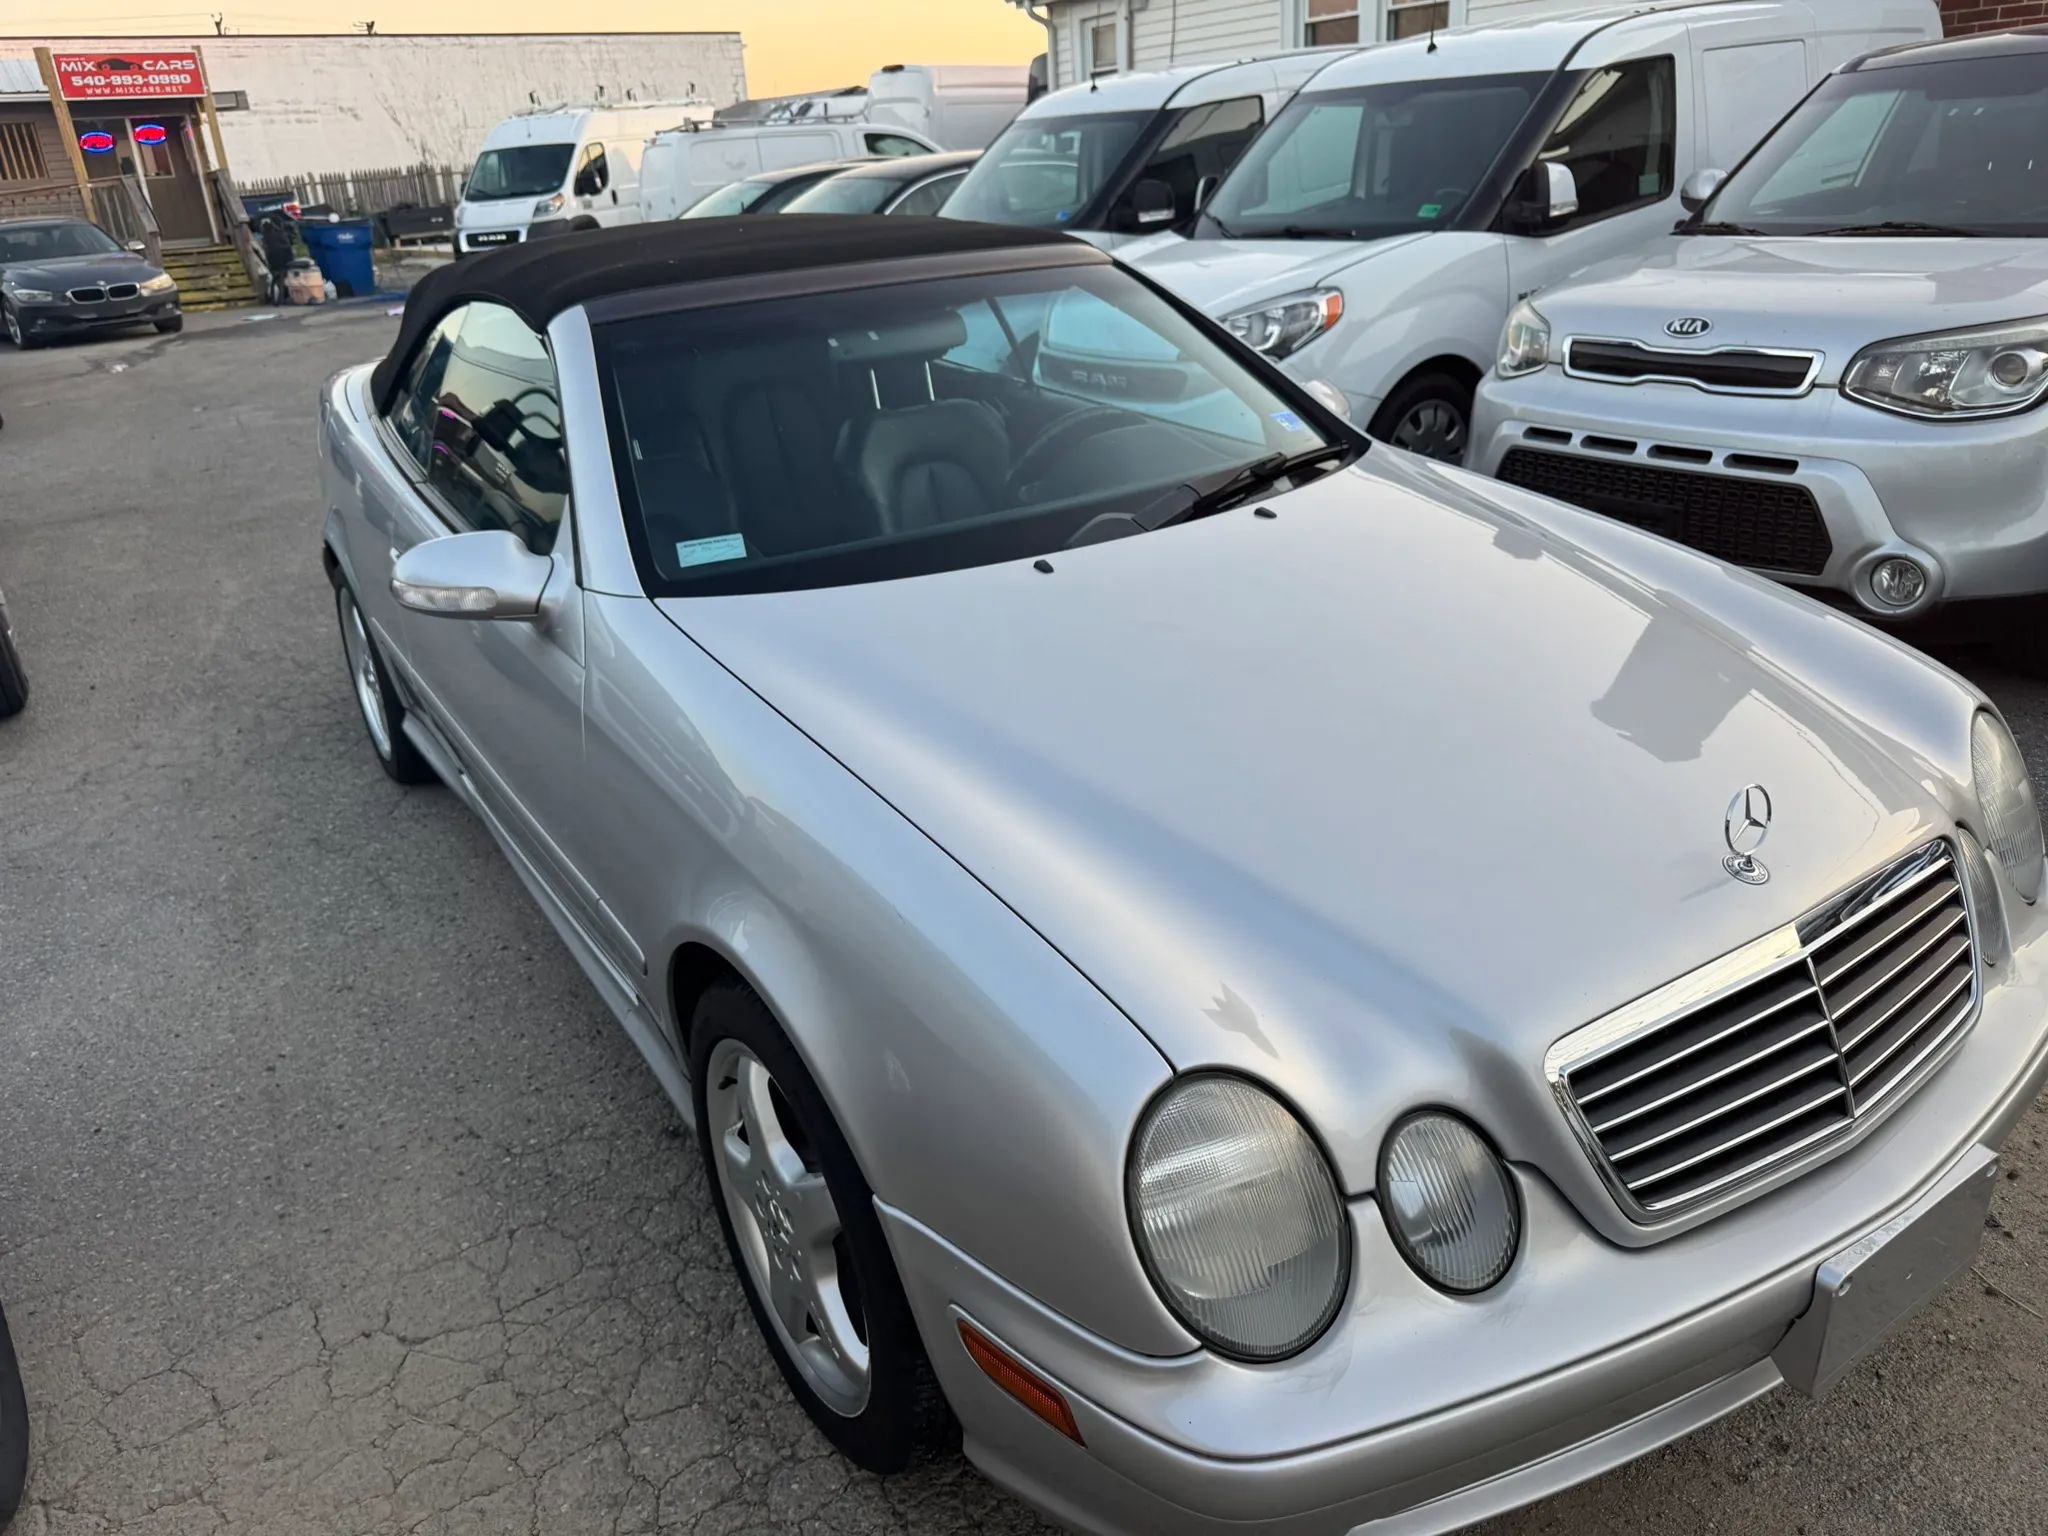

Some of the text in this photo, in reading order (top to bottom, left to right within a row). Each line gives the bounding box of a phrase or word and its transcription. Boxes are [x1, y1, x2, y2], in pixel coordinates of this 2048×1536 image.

[60, 59, 196, 72] MIX CARS
[1669, 319, 1703, 333] KIA
